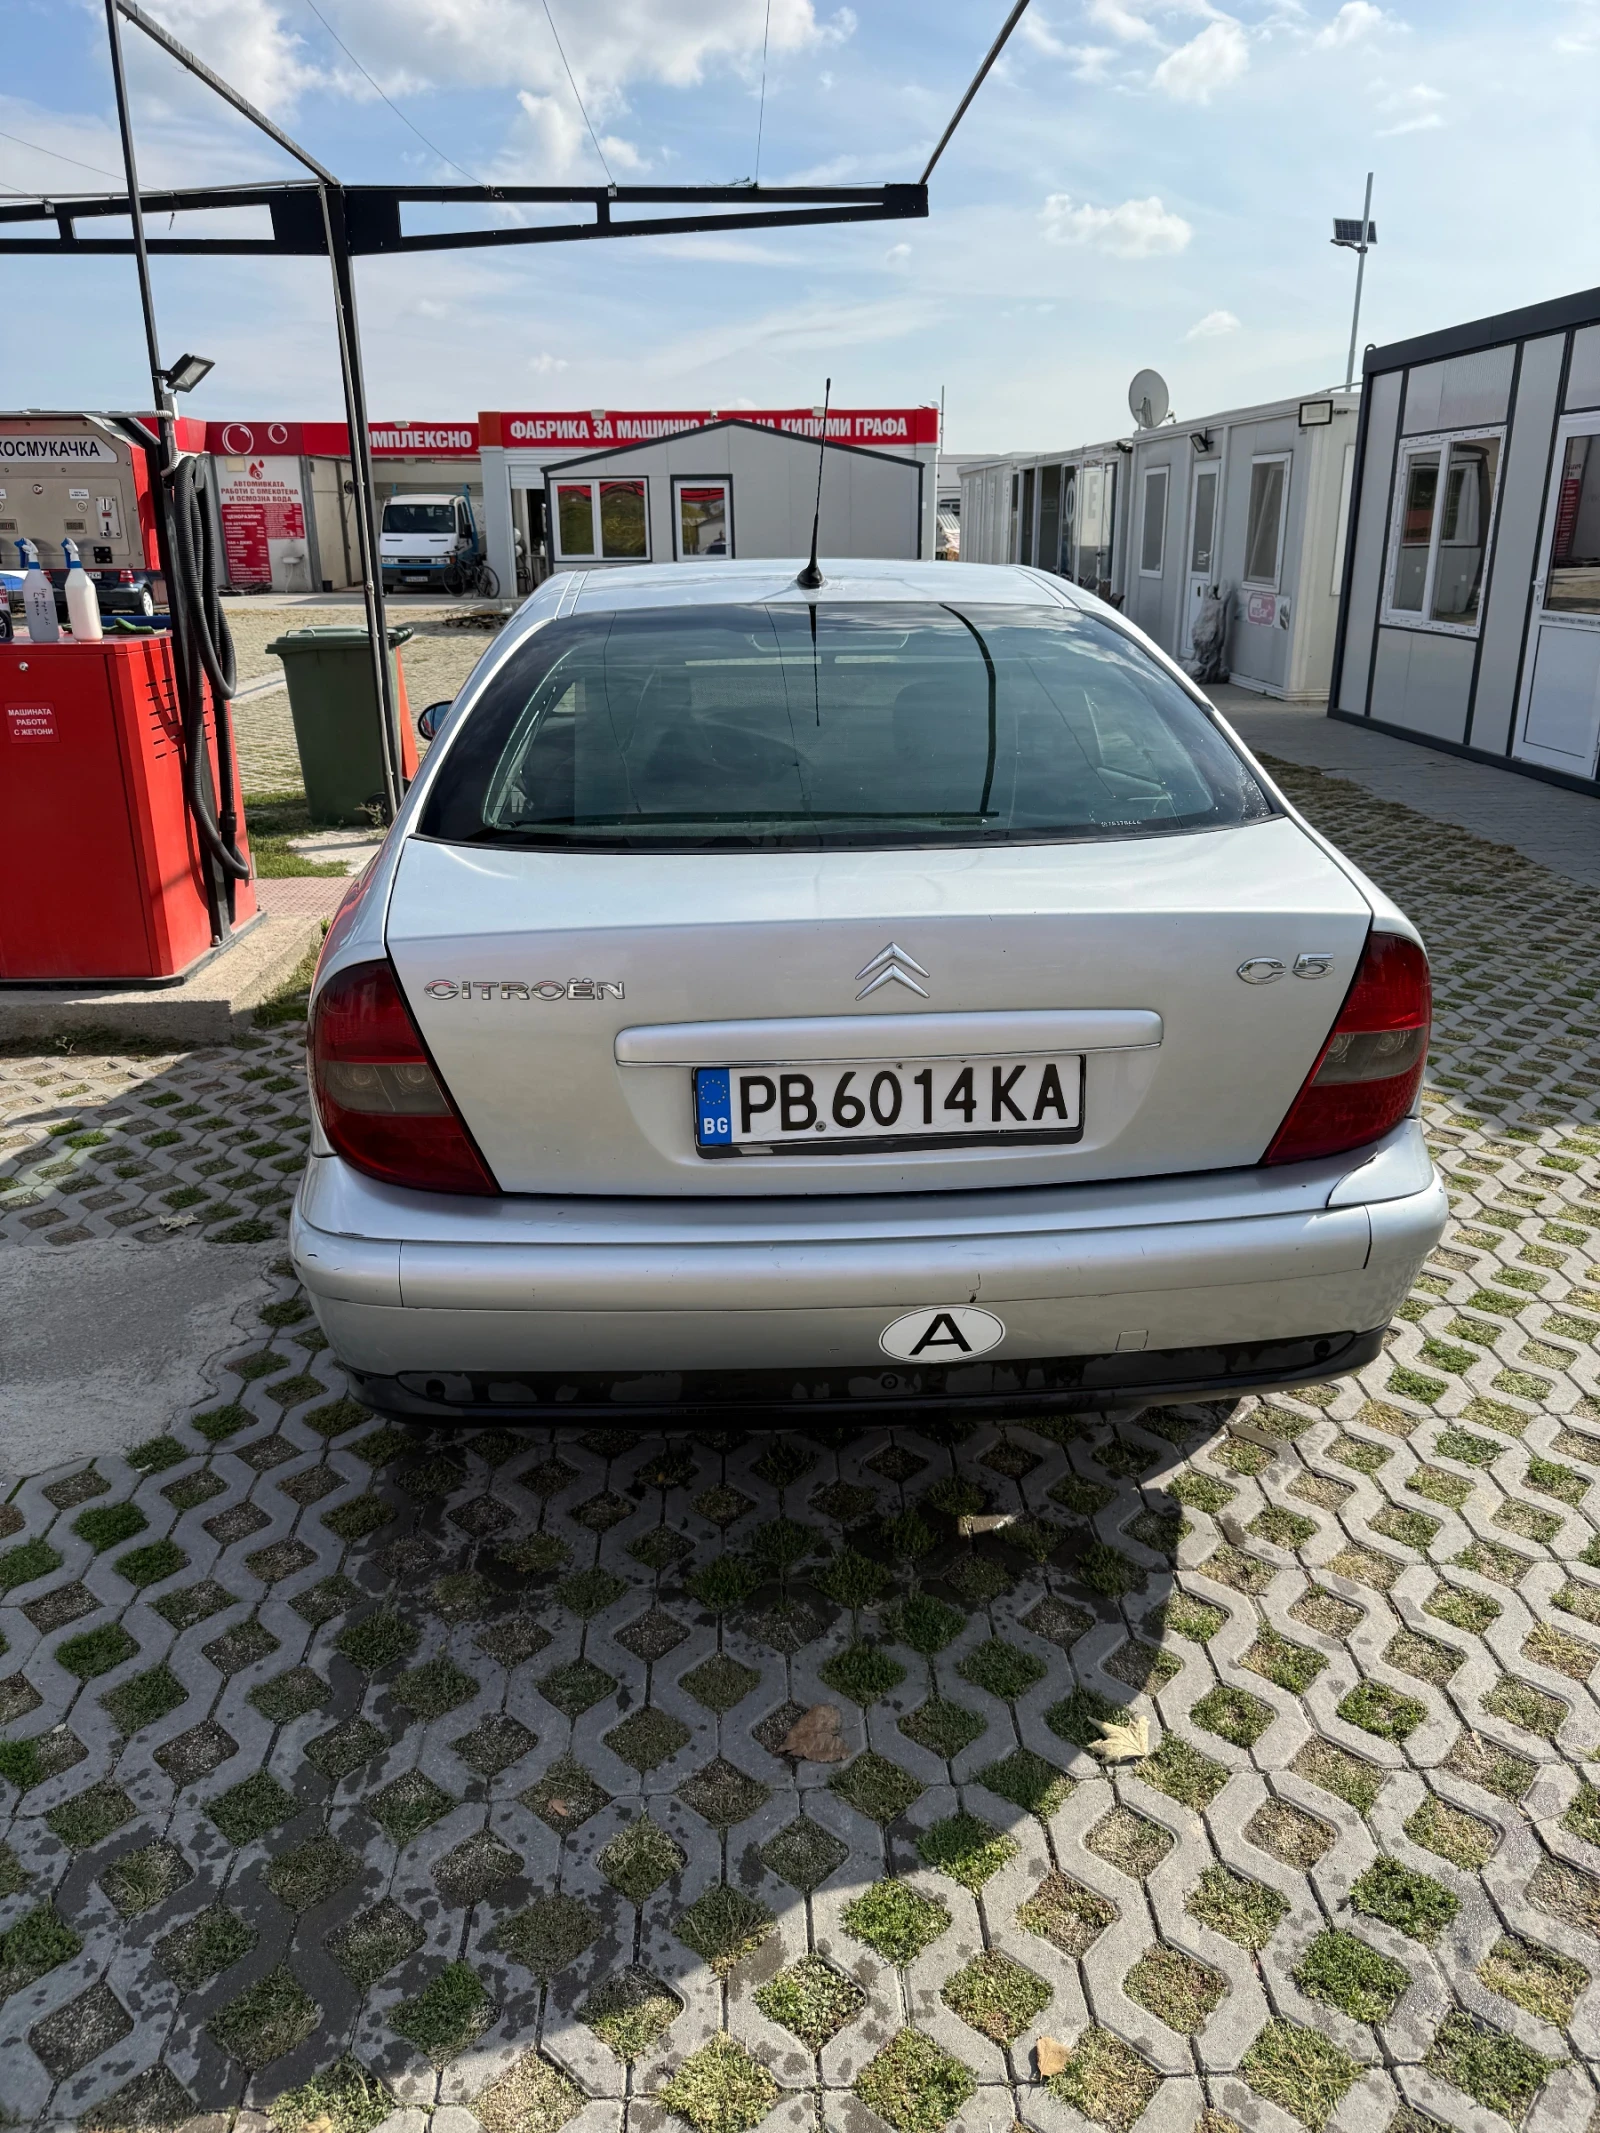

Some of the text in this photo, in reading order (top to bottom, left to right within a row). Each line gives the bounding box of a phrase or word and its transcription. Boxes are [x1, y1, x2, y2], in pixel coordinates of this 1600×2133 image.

[368, 430, 472, 449] МПЛЕКСНО
[510, 420, 590, 439] ФАБРИКА
[593, 420, 614, 438] ЗА
[781, 417, 851, 437] КИЛИМИ
[855, 417, 908, 436] ГРАФА
[1236, 953, 1335, 985] C5
[424, 977, 626, 1001] CITROËN
[703, 1116, 729, 1136] BG
[908, 1313, 973, 1356] A
